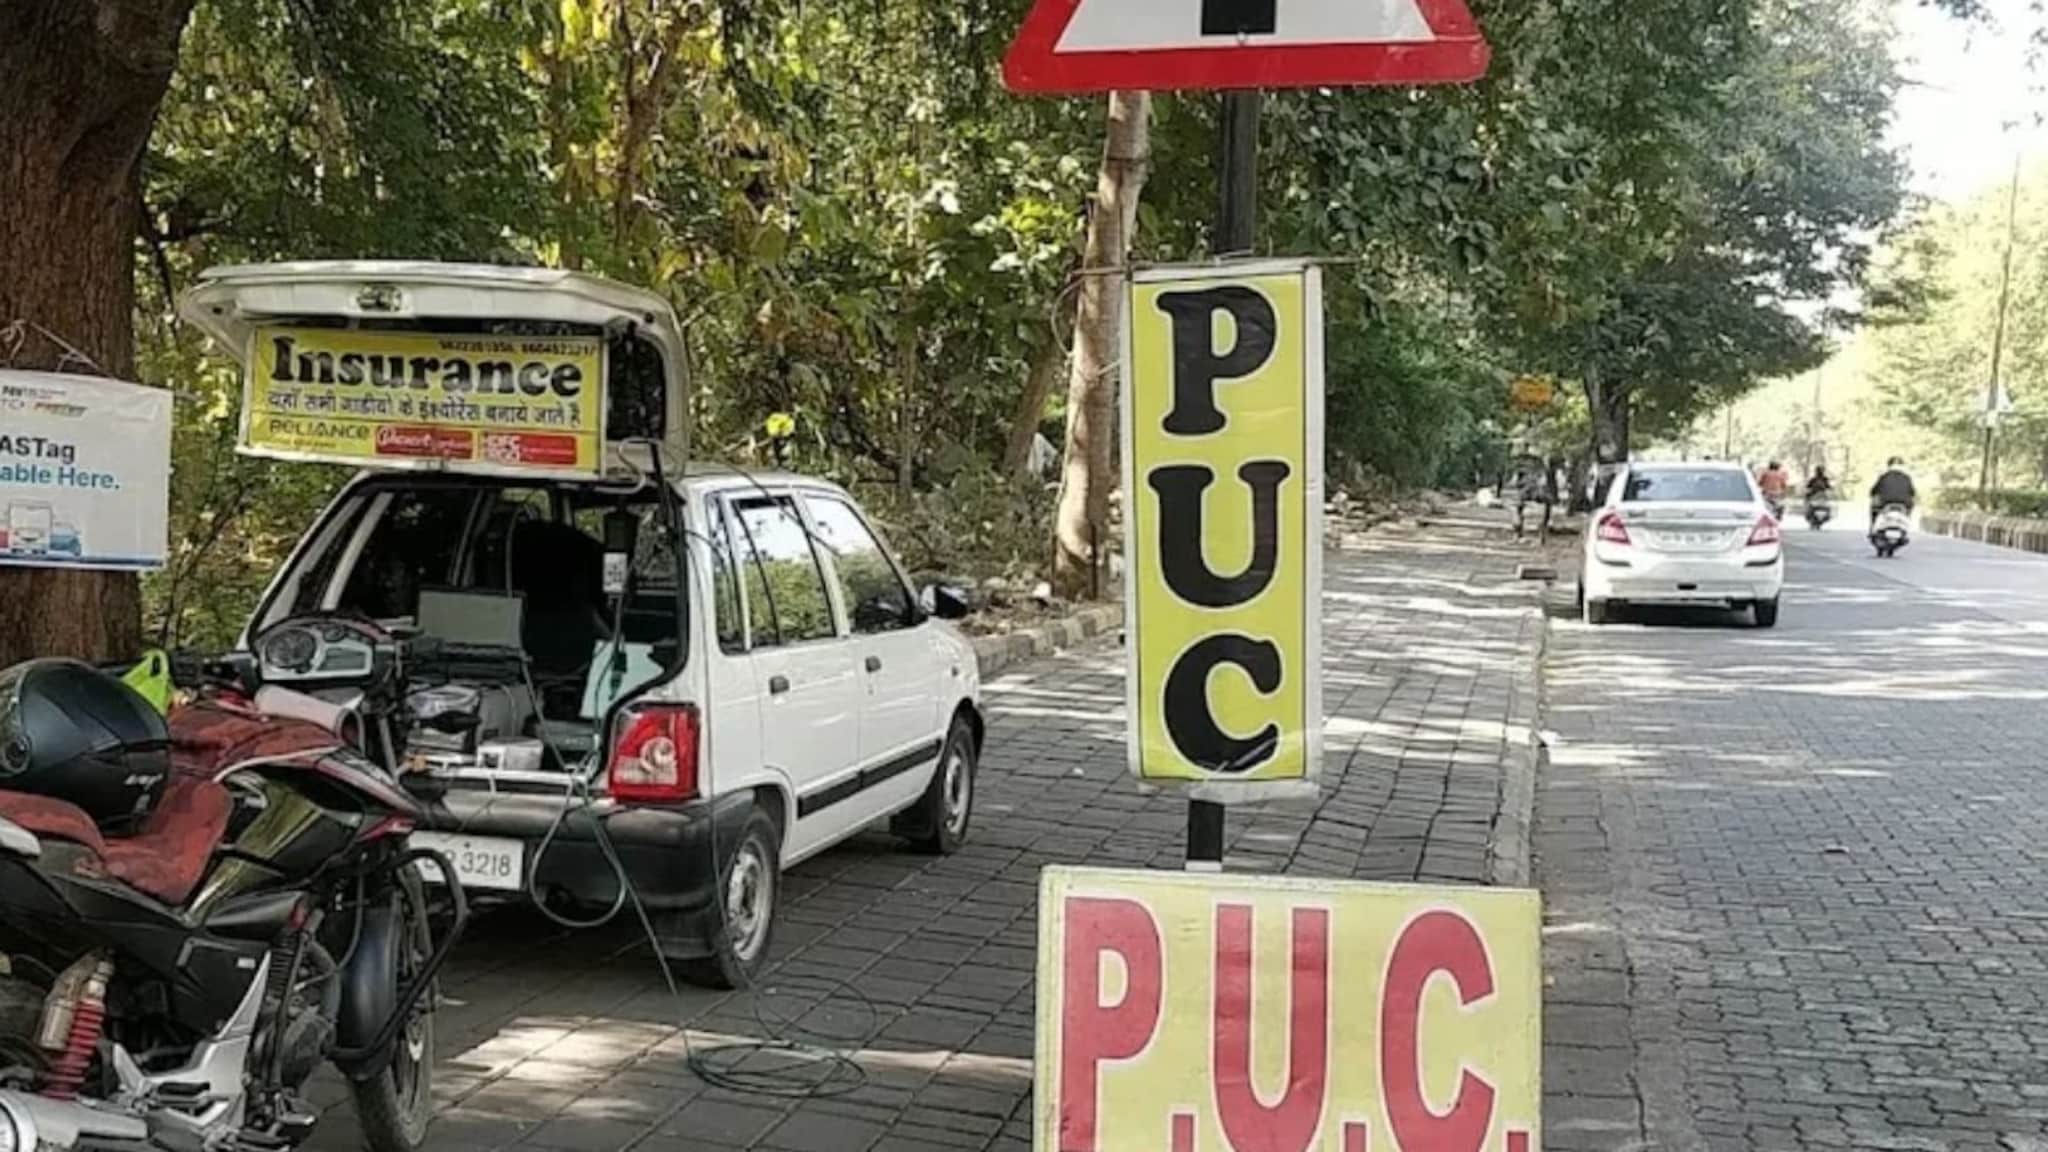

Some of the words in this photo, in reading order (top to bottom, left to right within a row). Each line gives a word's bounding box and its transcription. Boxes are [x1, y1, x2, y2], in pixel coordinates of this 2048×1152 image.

[271, 336, 583, 397] Insurance
[304, 390, 336, 412] सभी
[398, 393, 414, 416] के
[485, 400, 529, 423] बनाये
[533, 402, 565, 425] जाते
[0, 434, 75, 464] ASTag
[0, 463, 51, 484] able
[58, 466, 120, 490] Here.
[1147, 285, 1291, 772] PUC
[461, 851, 511, 877] 3218
[1058, 897, 1530, 1152] P.U.C.
